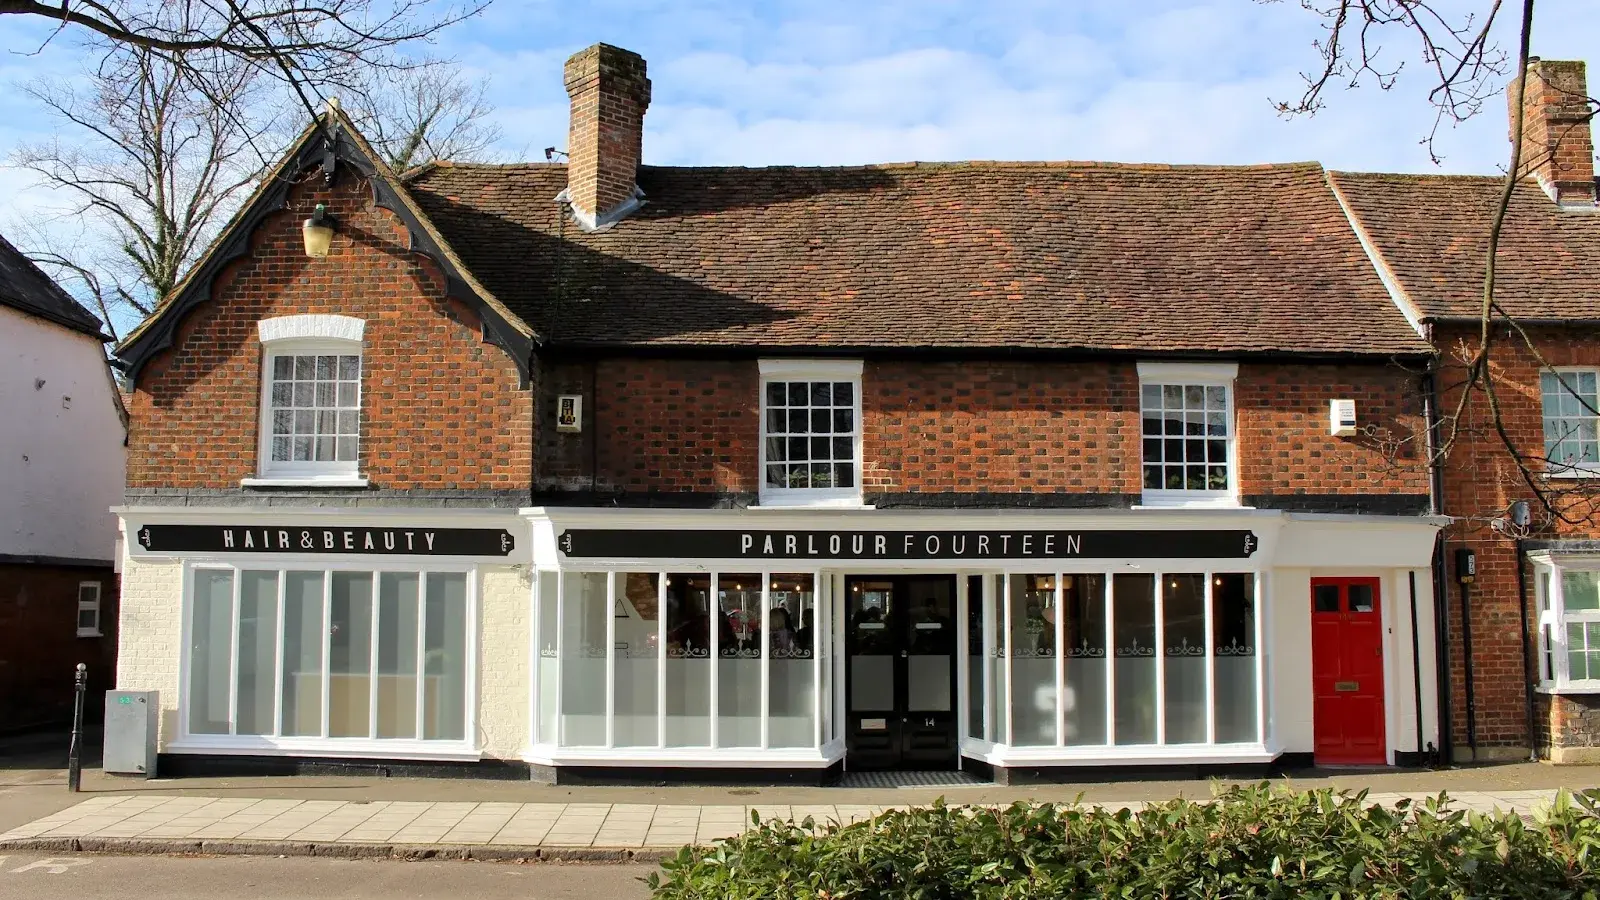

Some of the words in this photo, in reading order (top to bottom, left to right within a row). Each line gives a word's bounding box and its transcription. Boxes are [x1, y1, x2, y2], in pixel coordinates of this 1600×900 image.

[741, 533, 886, 555] PARLOUR
[904, 534, 1081, 555] FOURTEEN
[925, 717, 935, 727] 14
